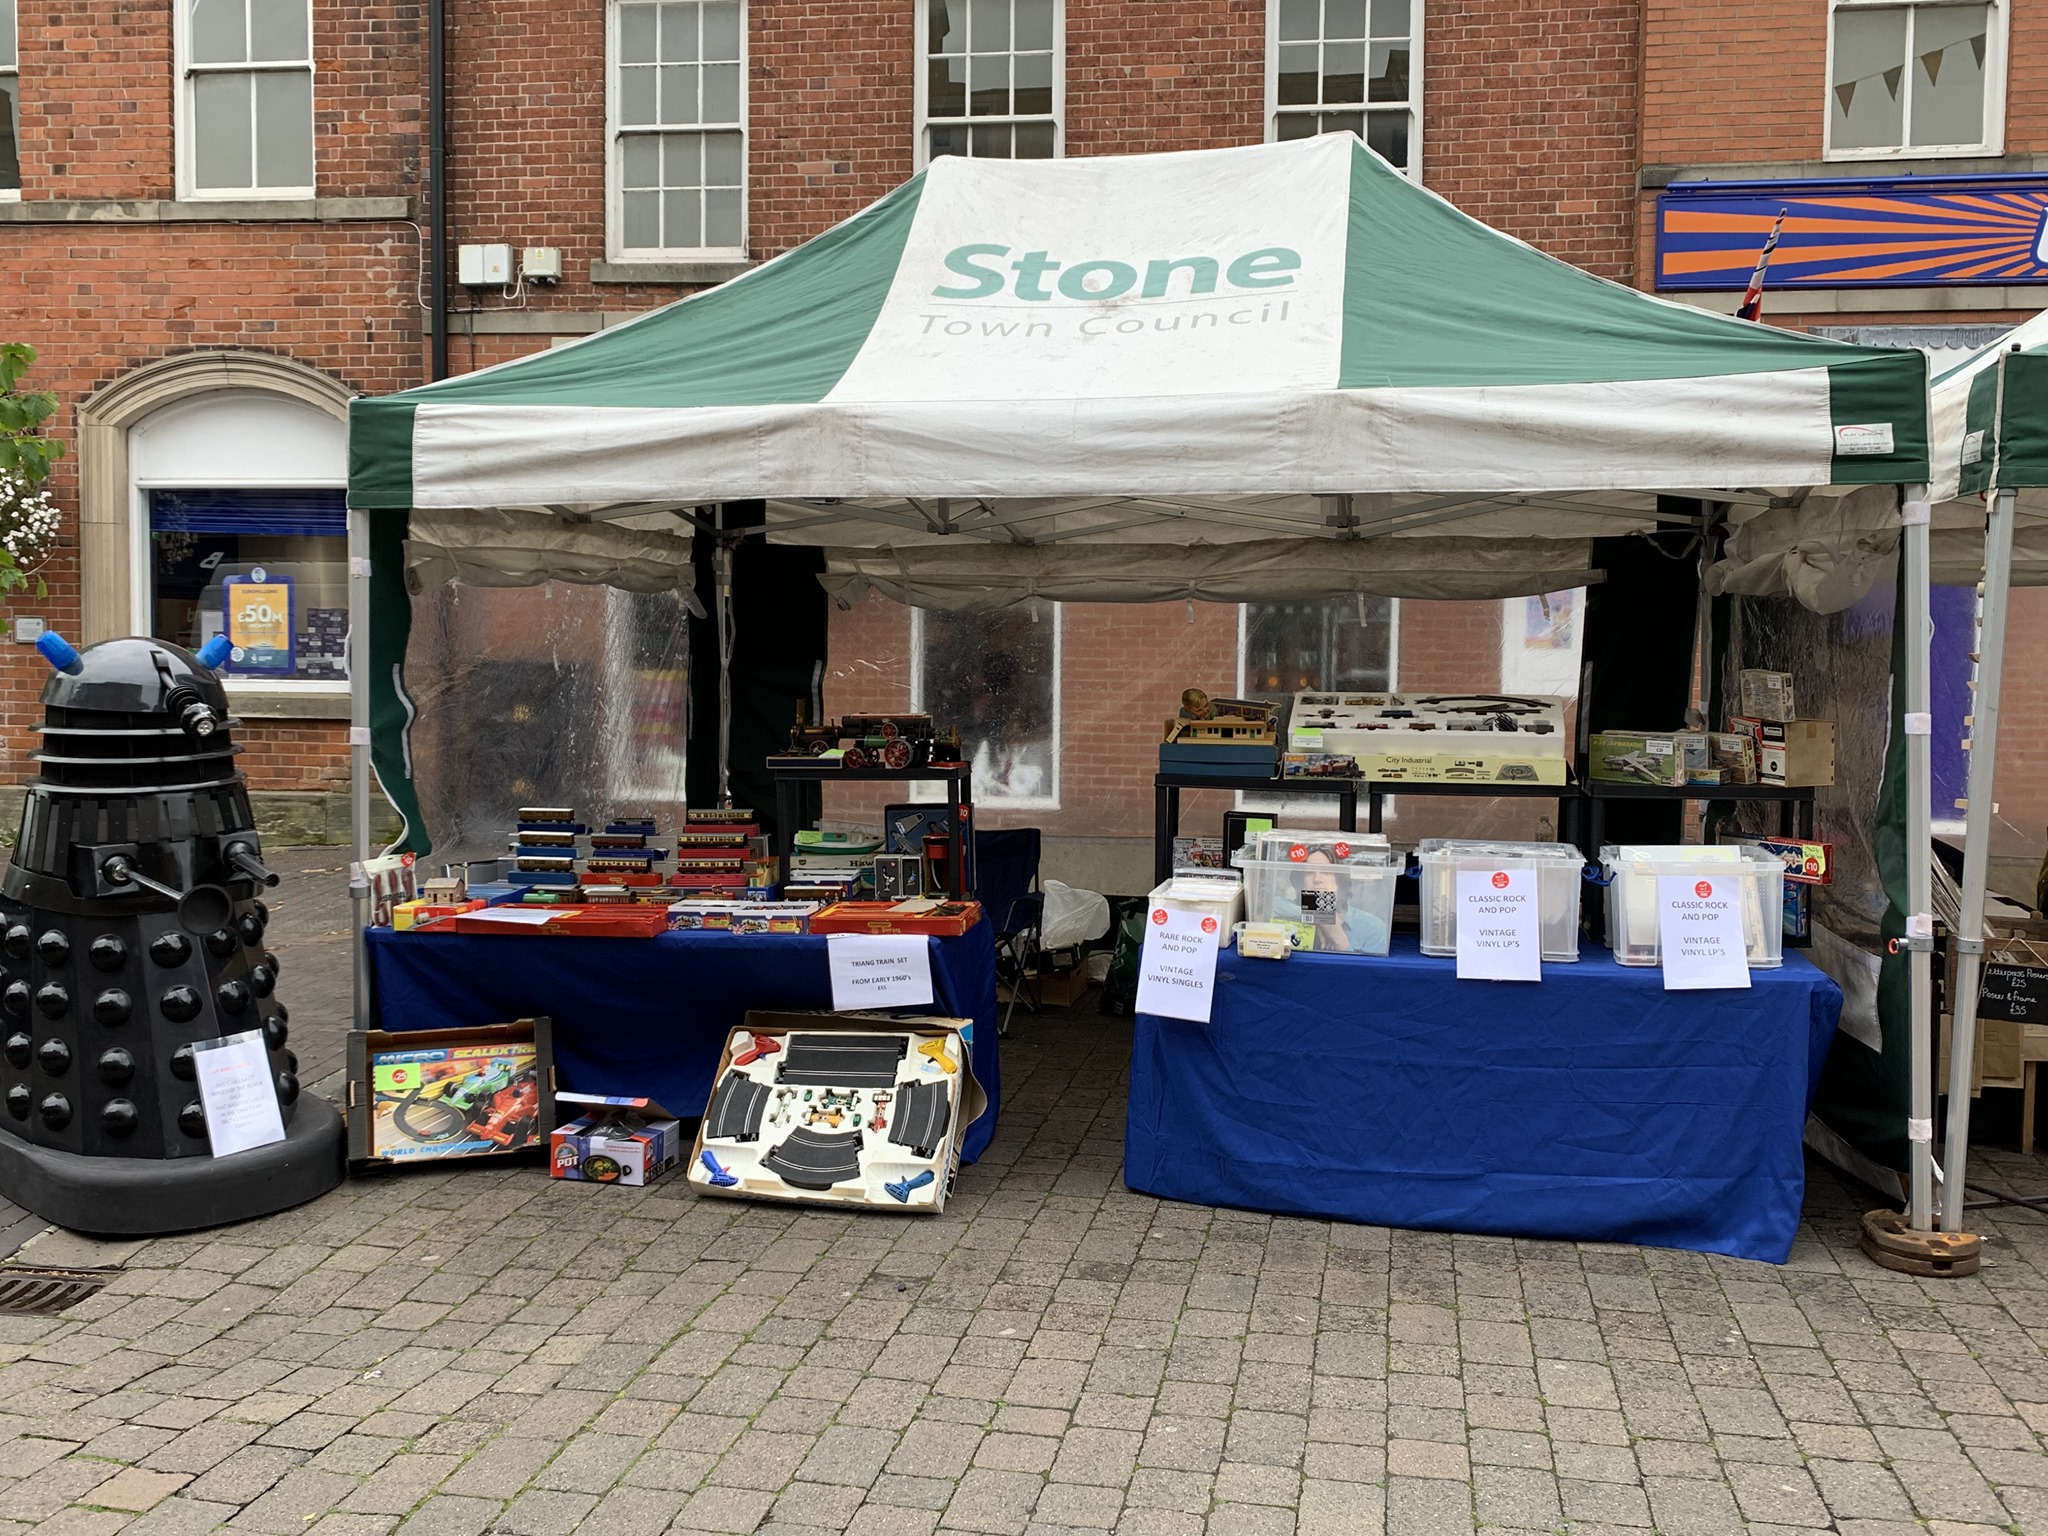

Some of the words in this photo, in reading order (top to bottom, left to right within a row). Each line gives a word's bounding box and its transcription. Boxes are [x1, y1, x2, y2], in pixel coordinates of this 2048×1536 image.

[931, 243, 1302, 301] Stone
[919, 314, 1053, 338] Town
[1079, 301, 1290, 336] Council
[238, 604, 283, 623] £50M
[1386, 756, 1400, 764] City
[1291, 849, 1305, 858] £10
[1806, 862, 1818, 872] £10
[1468, 895, 1501, 903] CLASSIC
[1672, 901, 1703, 909] CLASSIC
[1682, 913, 1700, 921] AND
[1702, 913, 1719, 921] POP
[1160, 932, 1179, 941] RARE
[1181, 935, 1203, 944] ROCK
[1162, 944, 1179, 952] AND
[1181, 946, 1197, 954] POP
[1160, 965, 1194, 976] VINTAGE
[1986, 968, 2026, 981] etterpress
[892, 974, 911, 982] 1960's
[1148, 974, 1169, 985] VINYL
[1172, 978, 1203, 989] SINGLES
[2011, 977, 2027, 988] £25
[2012, 990, 2037, 1003] frame
[2010, 1002, 2027, 1015] £35
[378, 1051, 445, 1065] MICRO
[381, 1148, 415, 1157] WORLD
[556, 1155, 579, 1169] POT
